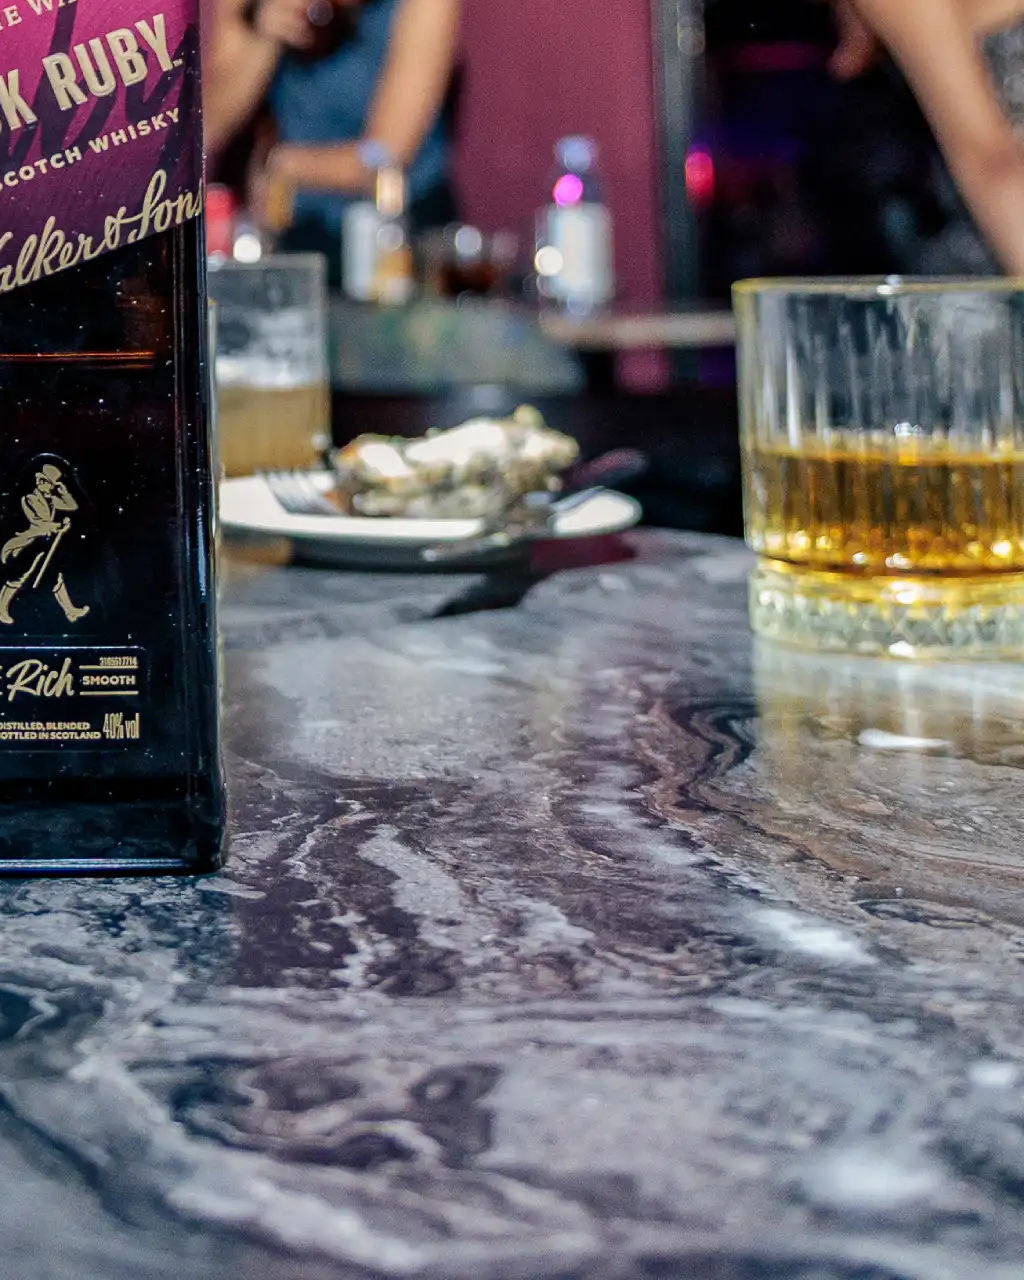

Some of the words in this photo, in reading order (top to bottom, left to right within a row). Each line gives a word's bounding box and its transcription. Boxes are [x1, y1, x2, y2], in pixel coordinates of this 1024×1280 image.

[42, 13, 173, 111] RUBY
[88, 108, 180, 155] WHISKY
[127, 168, 203, 244] Sons
[6, 657, 75, 702] Rich
[82, 675, 136, 686] SMOOTH
[38, 731, 49, 740] IN
[49, 731, 102, 740] SCOTLAND
[46, 721, 91, 730] BLENDED
[102, 712, 124, 739] 40%
[124, 712, 140, 739] vol
